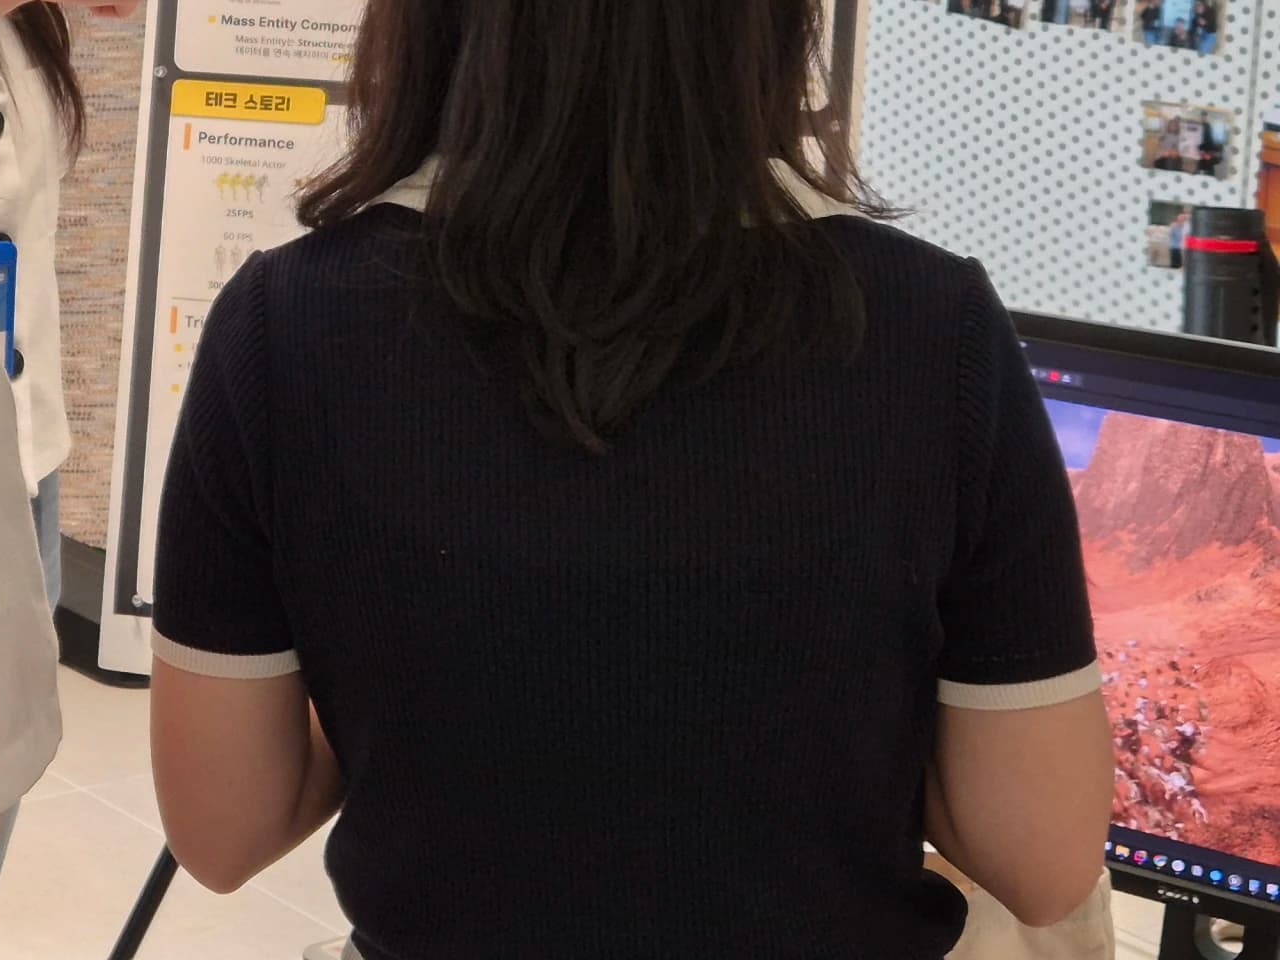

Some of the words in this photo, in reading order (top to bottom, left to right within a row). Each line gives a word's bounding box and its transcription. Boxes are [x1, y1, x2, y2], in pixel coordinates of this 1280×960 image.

[221, 14, 256, 27] Mass
[258, 16, 298, 31] Entity
[205, 90, 238, 108] 테크
[244, 93, 291, 112] 스토리
[197, 131, 296, 150] Performance
[201, 155, 223, 166] 1000
[224, 156, 260, 168] Skeletal
[262, 158, 287, 169] Actor
[225, 208, 255, 219] 25FPS
